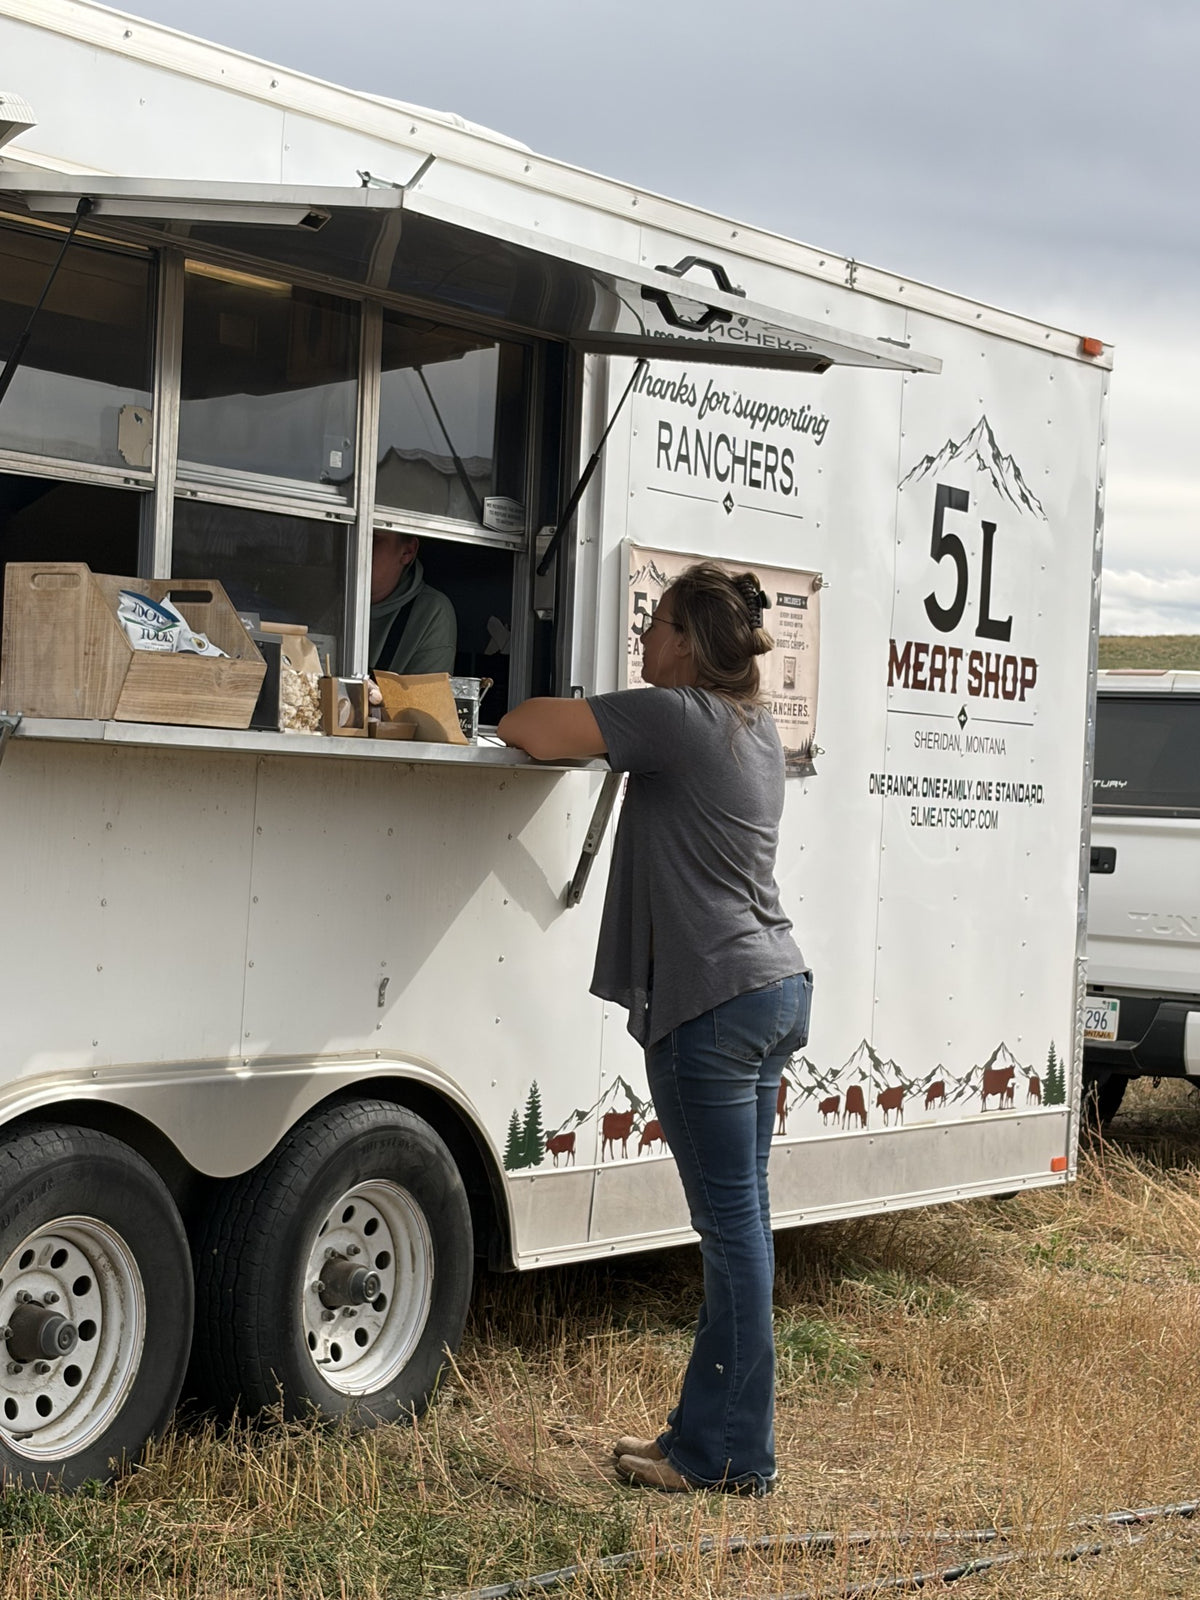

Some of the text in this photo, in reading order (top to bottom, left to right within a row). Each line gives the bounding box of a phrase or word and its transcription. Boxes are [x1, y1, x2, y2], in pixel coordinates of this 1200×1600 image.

[633, 359, 830, 446] Thanks for supporting
[656, 420, 799, 497] RANCHERS.
[923, 482, 1013, 642] 5L
[886, 638, 1038, 702] MEAT SHOP
[914, 730, 1007, 755] SHERIDAN, MONTANA
[869, 773, 1045, 804] ONE RANCH. ONE FAMILY. ONE STANDARD.
[1093, 779, 1128, 788] TURY
[910, 806, 999, 830] 5LMEATSHOP.COM
[1127, 911, 1200, 937] TUN
[1085, 1010, 1108, 1030] 296
